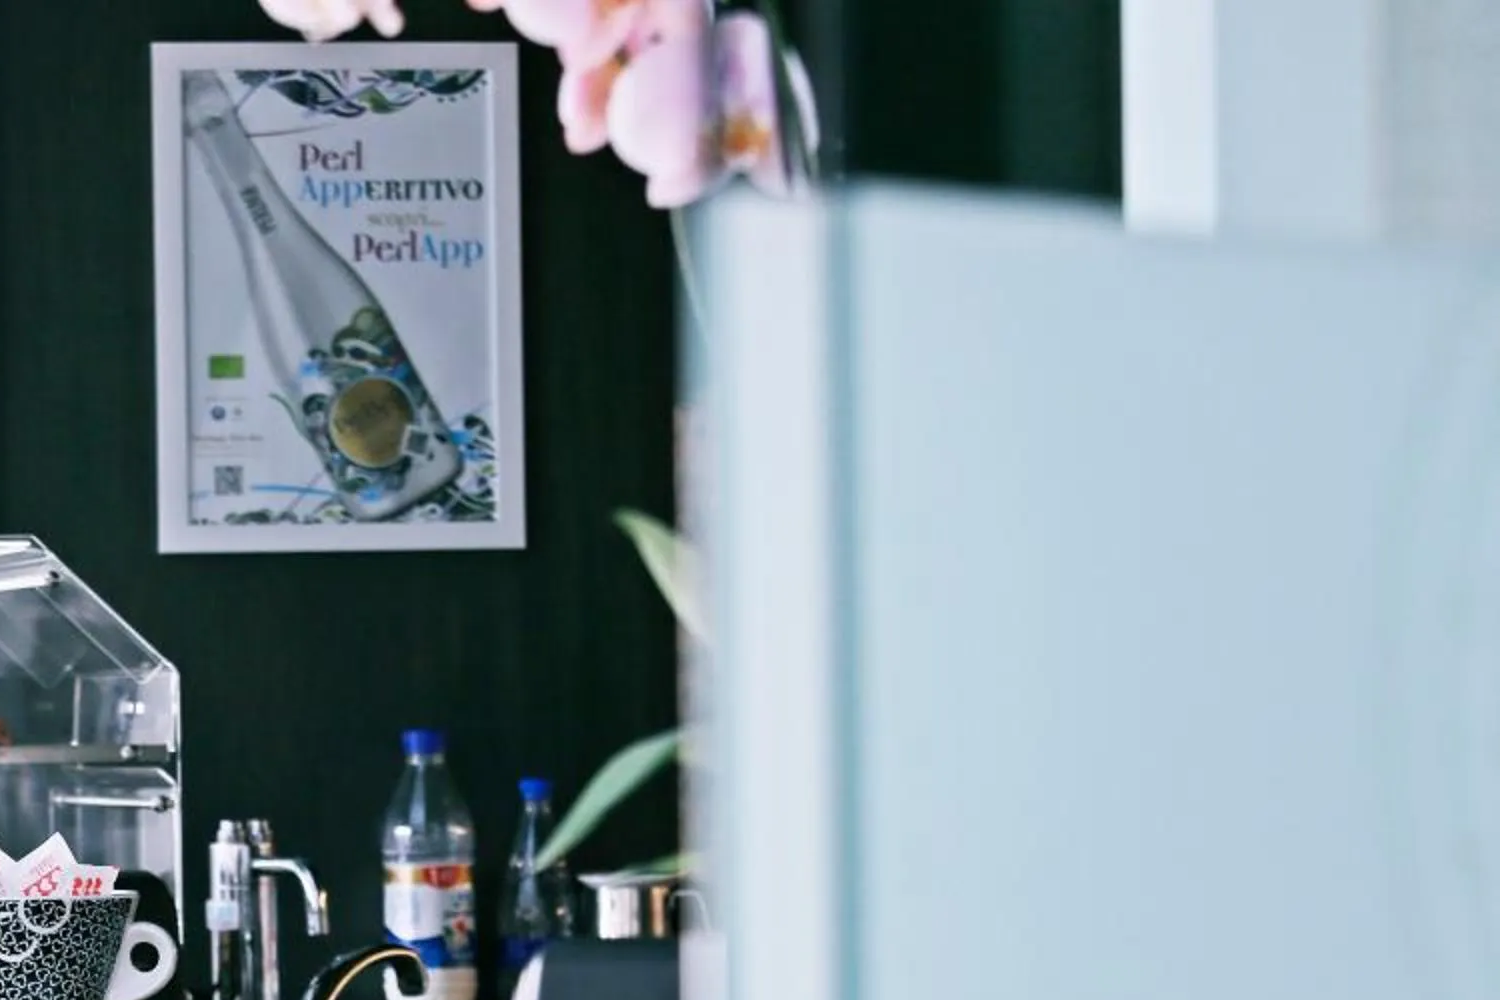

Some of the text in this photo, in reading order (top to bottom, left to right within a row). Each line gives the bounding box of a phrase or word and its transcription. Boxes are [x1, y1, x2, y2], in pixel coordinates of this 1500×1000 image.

[299, 140, 364, 171] Perl
[299, 176, 484, 208] AppERITIVO
[353, 230, 485, 268] PerlApp
